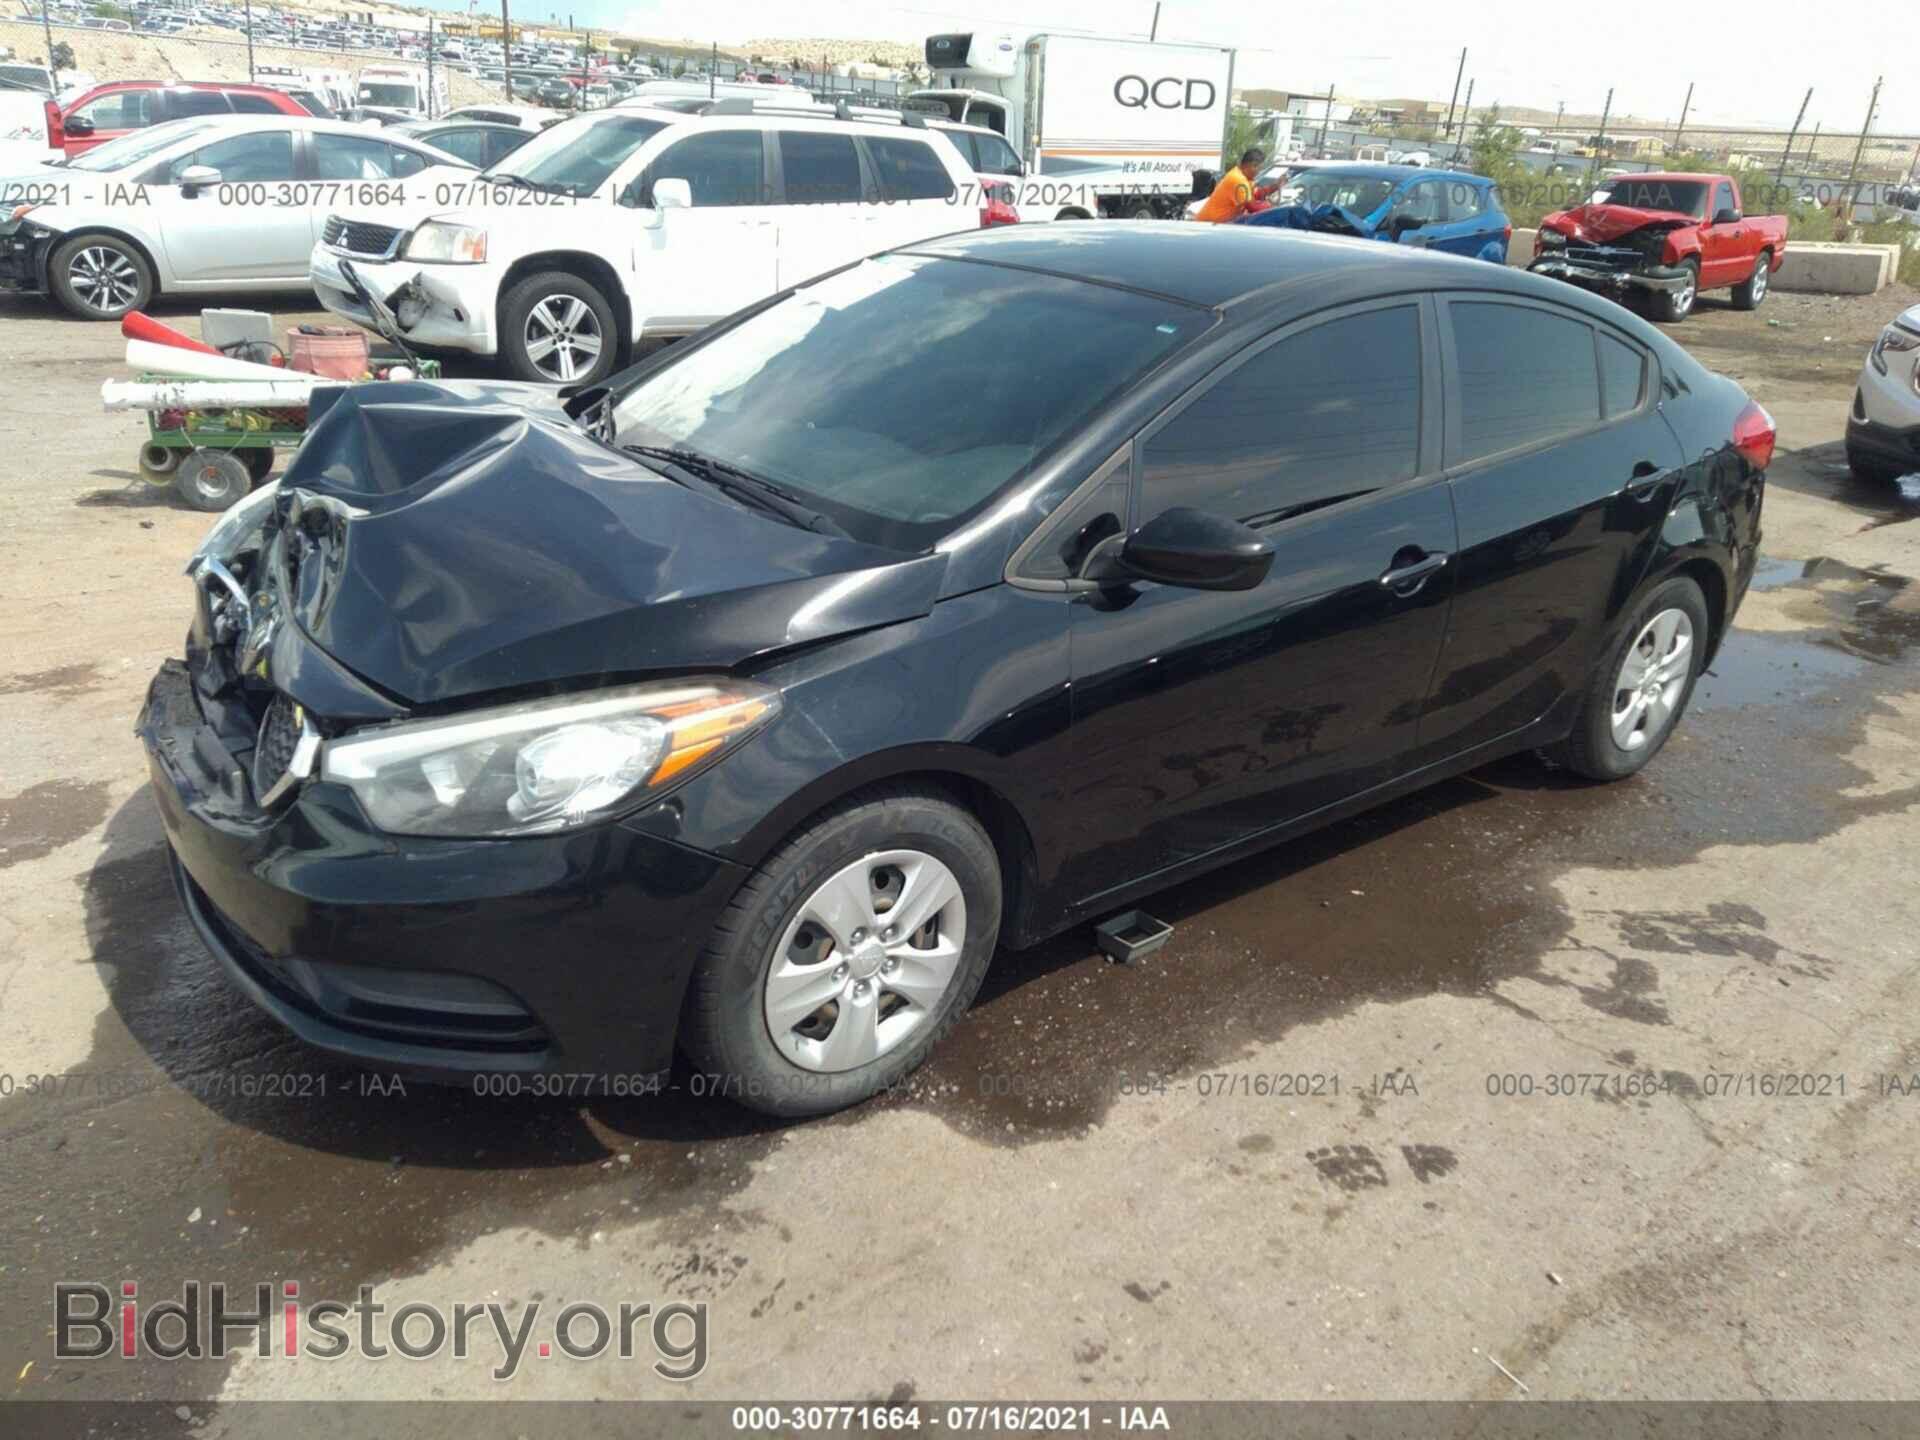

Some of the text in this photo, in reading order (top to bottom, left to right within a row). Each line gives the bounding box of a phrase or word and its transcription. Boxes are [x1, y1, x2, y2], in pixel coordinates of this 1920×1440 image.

[1114, 74, 1216, 110] QCD
[1122, 160, 1136, 173] It's
[1138, 160, 1152, 173] All
[1153, 160, 1182, 173] About
